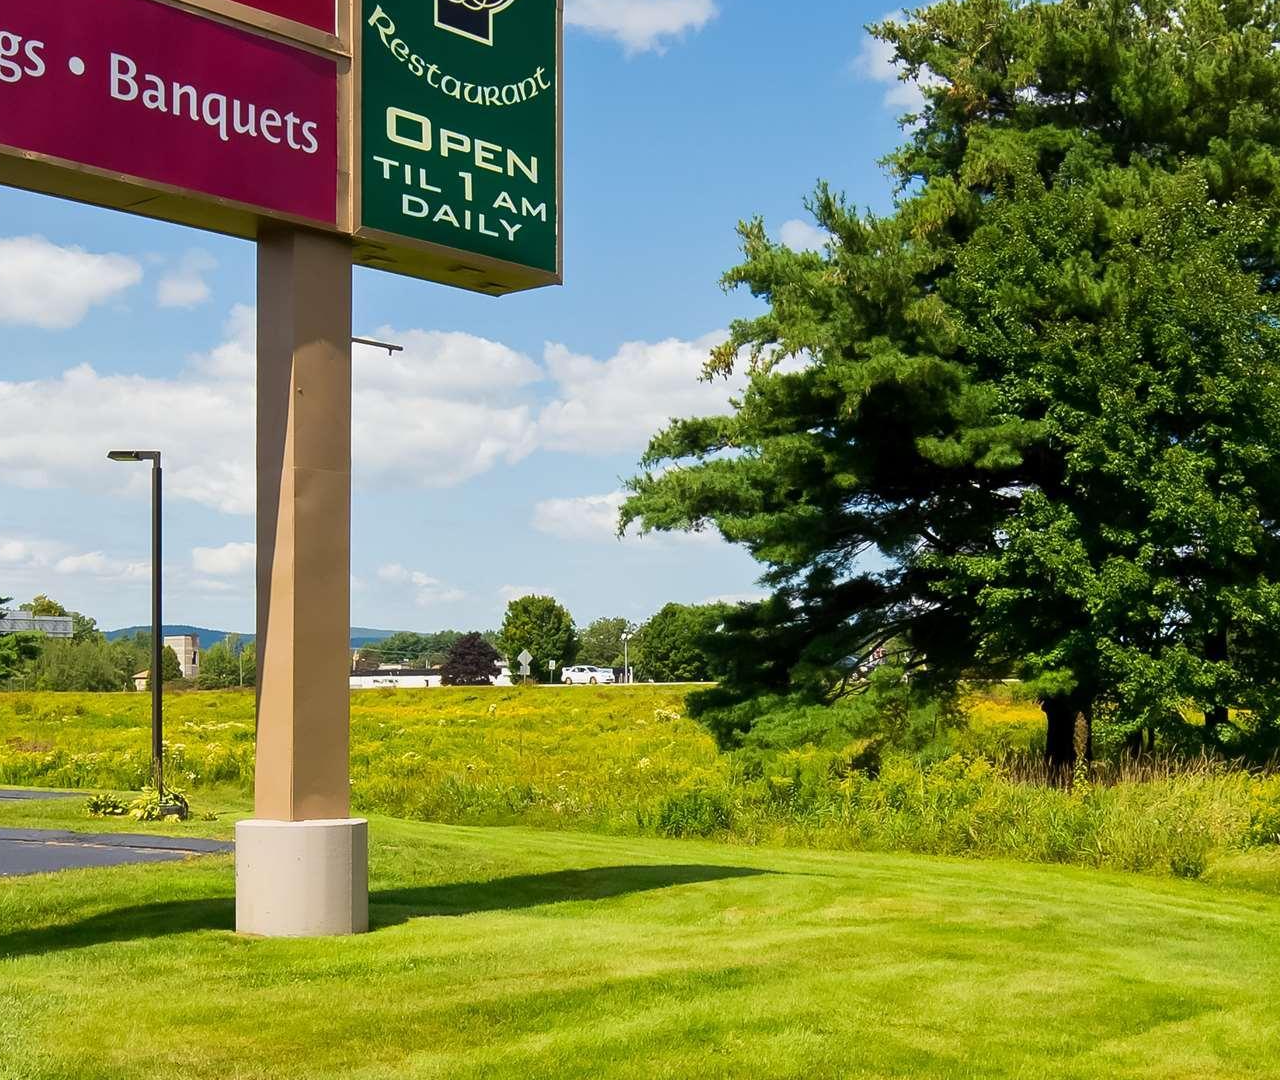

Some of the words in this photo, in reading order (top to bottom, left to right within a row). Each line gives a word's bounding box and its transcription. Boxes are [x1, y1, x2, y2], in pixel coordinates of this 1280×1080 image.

[367, 4, 551, 106] Restaurant
[110, 52, 318, 154] Banquets
[386, 106, 538, 184] OPEN
[372, 155, 442, 193] TIL
[458, 171, 473, 202] 1
[492, 191, 547, 222] AM
[402, 193, 522, 241] DAILY
